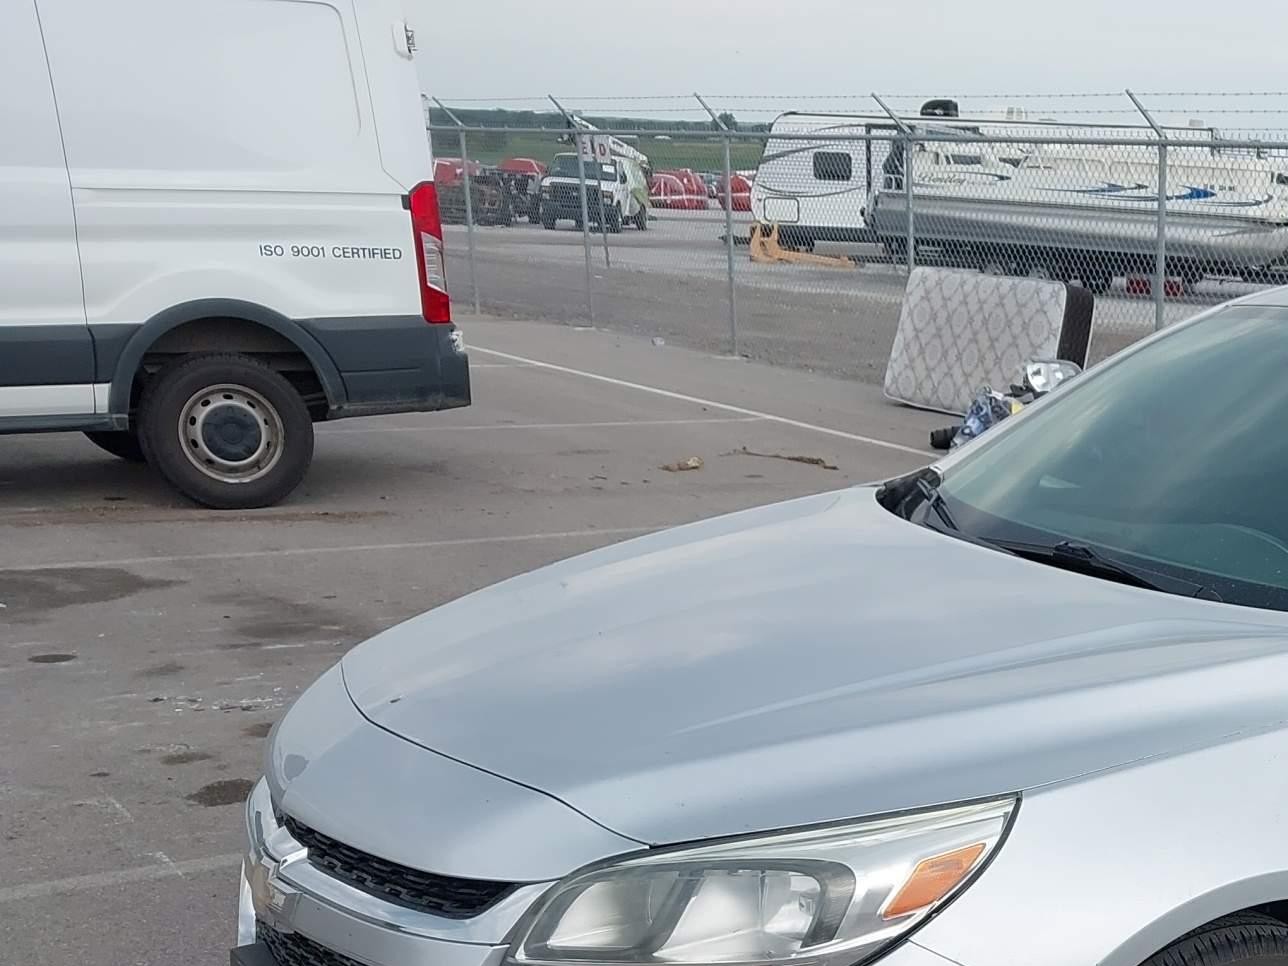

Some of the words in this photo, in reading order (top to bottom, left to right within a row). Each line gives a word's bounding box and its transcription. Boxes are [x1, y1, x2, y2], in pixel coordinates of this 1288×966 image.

[258, 244, 284, 257] ISO
[290, 245, 326, 258] 9001
[331, 246, 402, 260] CERTIFIED
